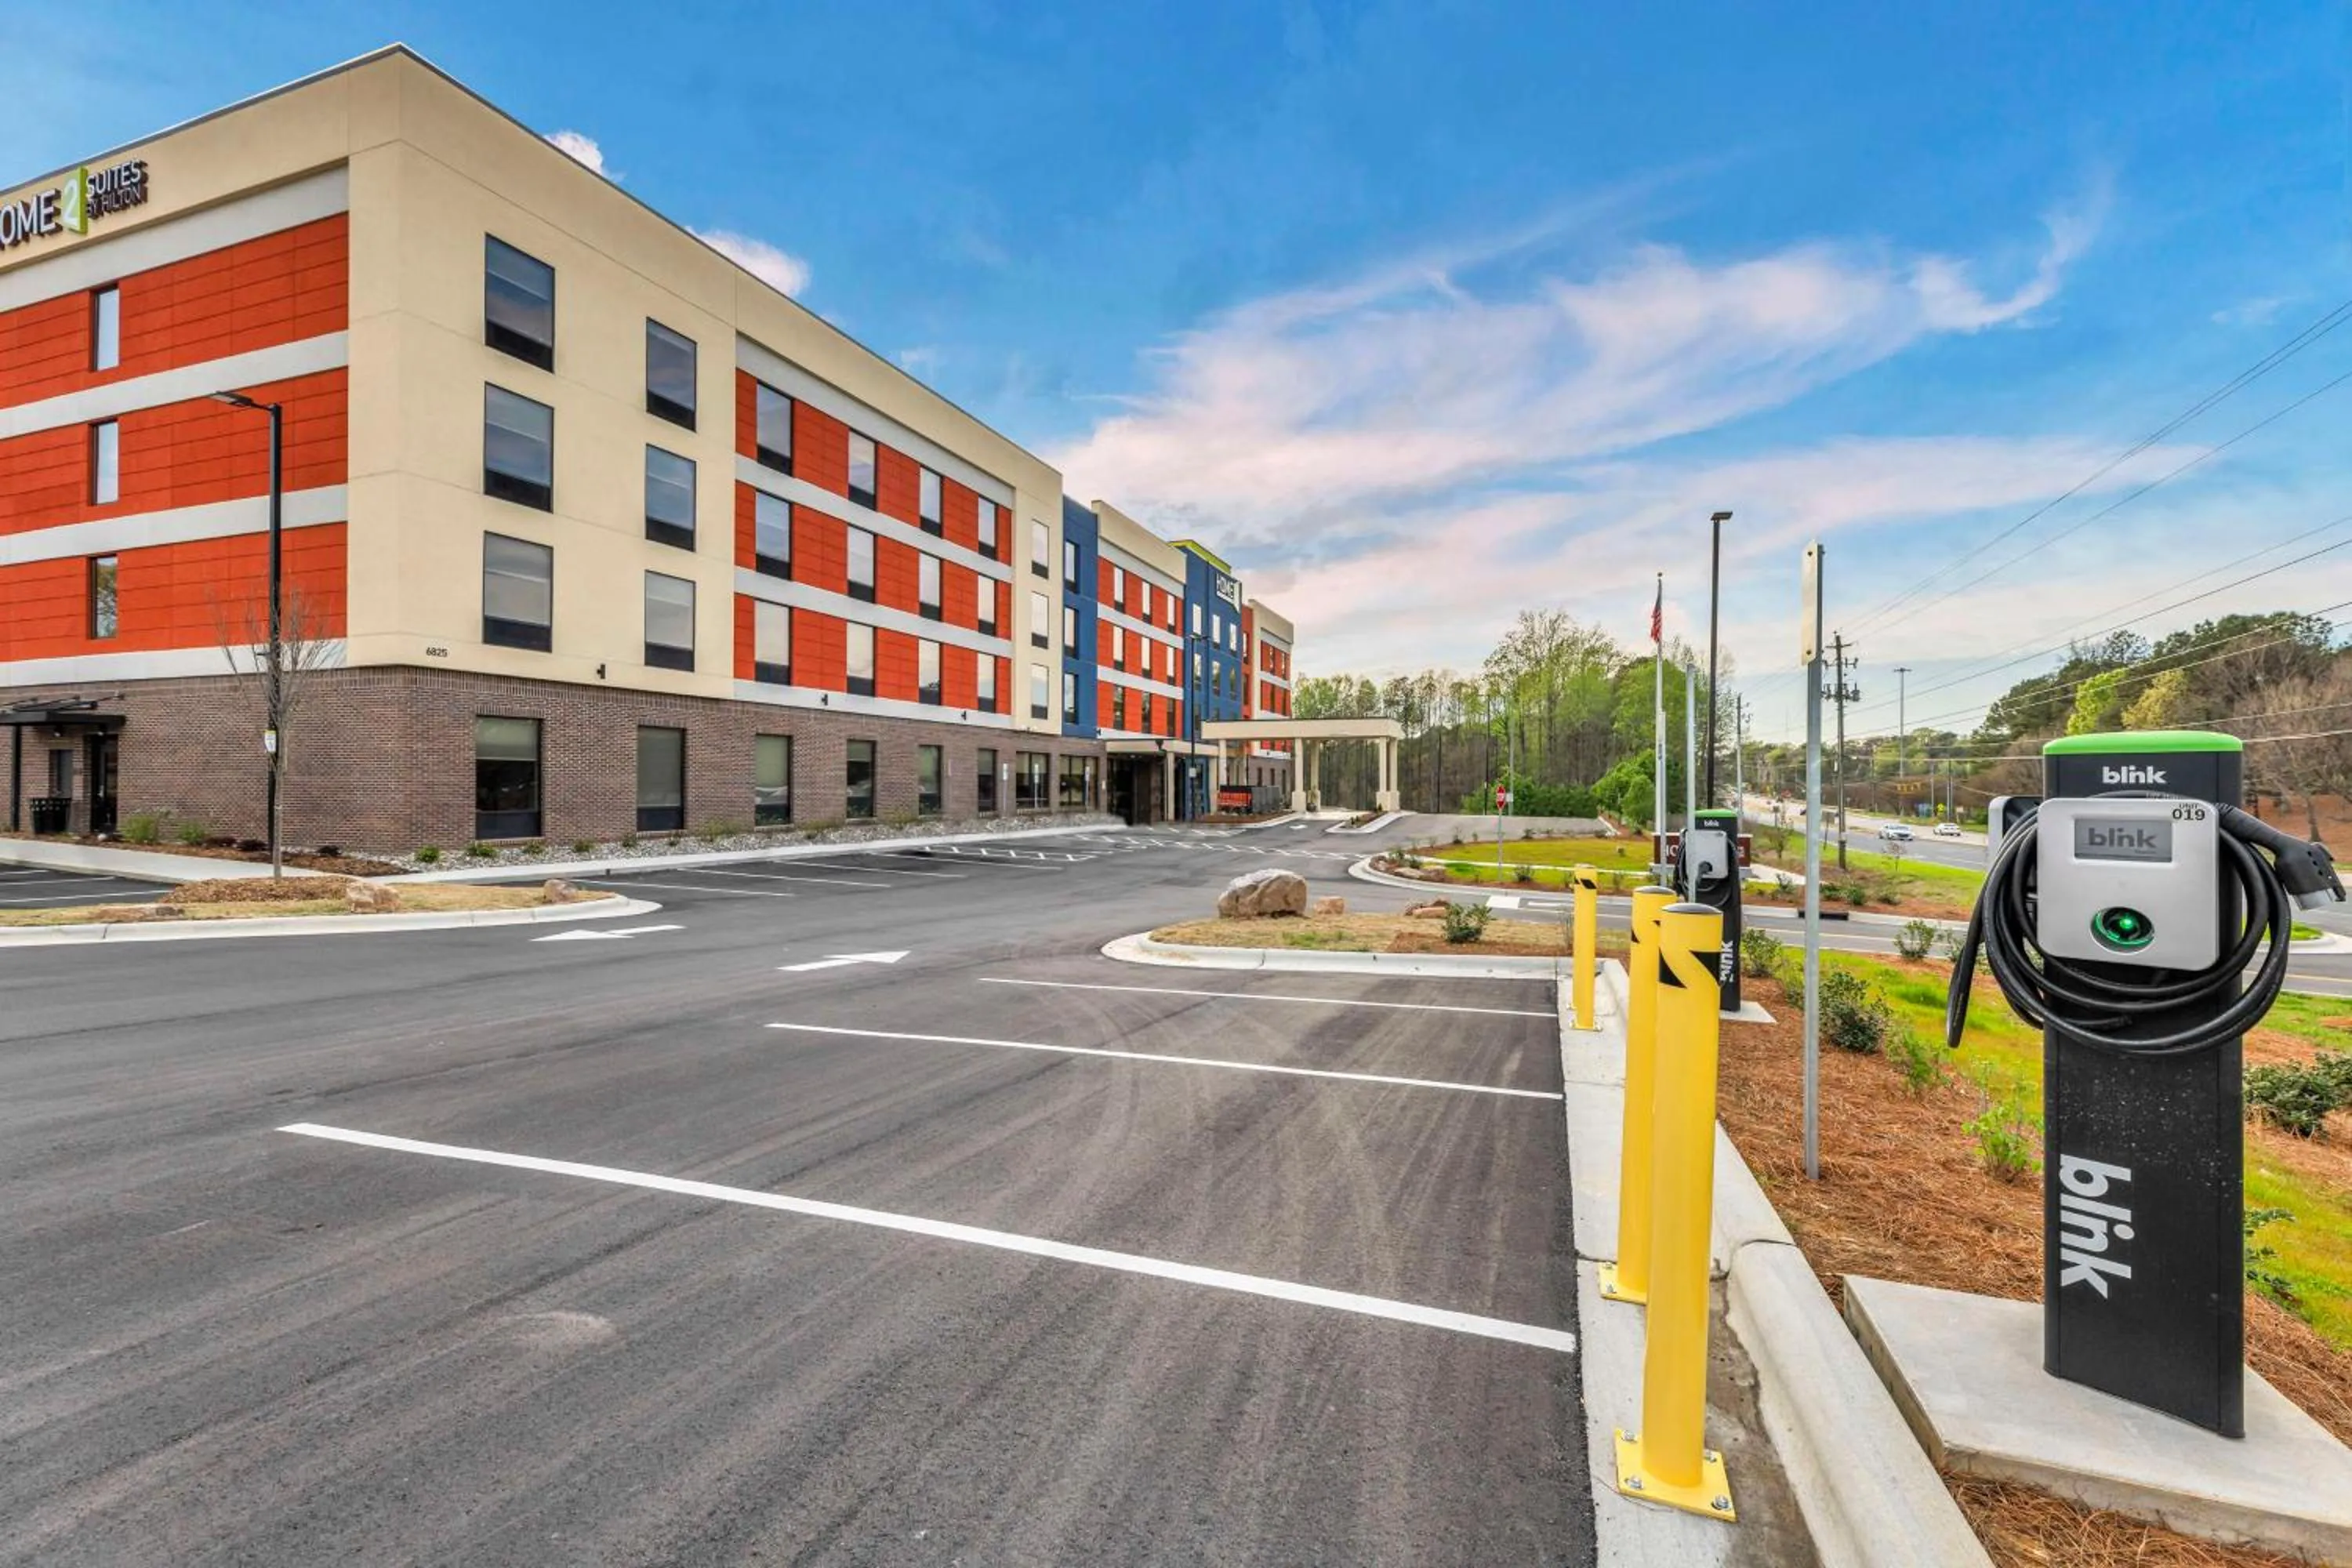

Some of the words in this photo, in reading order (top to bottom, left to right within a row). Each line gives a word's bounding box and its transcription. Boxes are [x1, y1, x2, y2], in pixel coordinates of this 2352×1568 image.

[0, 188, 56, 245] OME
[62, 178, 78, 227] 2
[86, 159, 140, 198] SUITES
[86, 198, 99, 215] BY
[102, 184, 140, 212] HILTON
[426, 647, 448, 658] 6825
[2102, 764, 2168, 785] blink
[2172, 808, 2205, 821] 019
[2089, 827, 2158, 848] blink
[2059, 1153, 2136, 1299] blink
